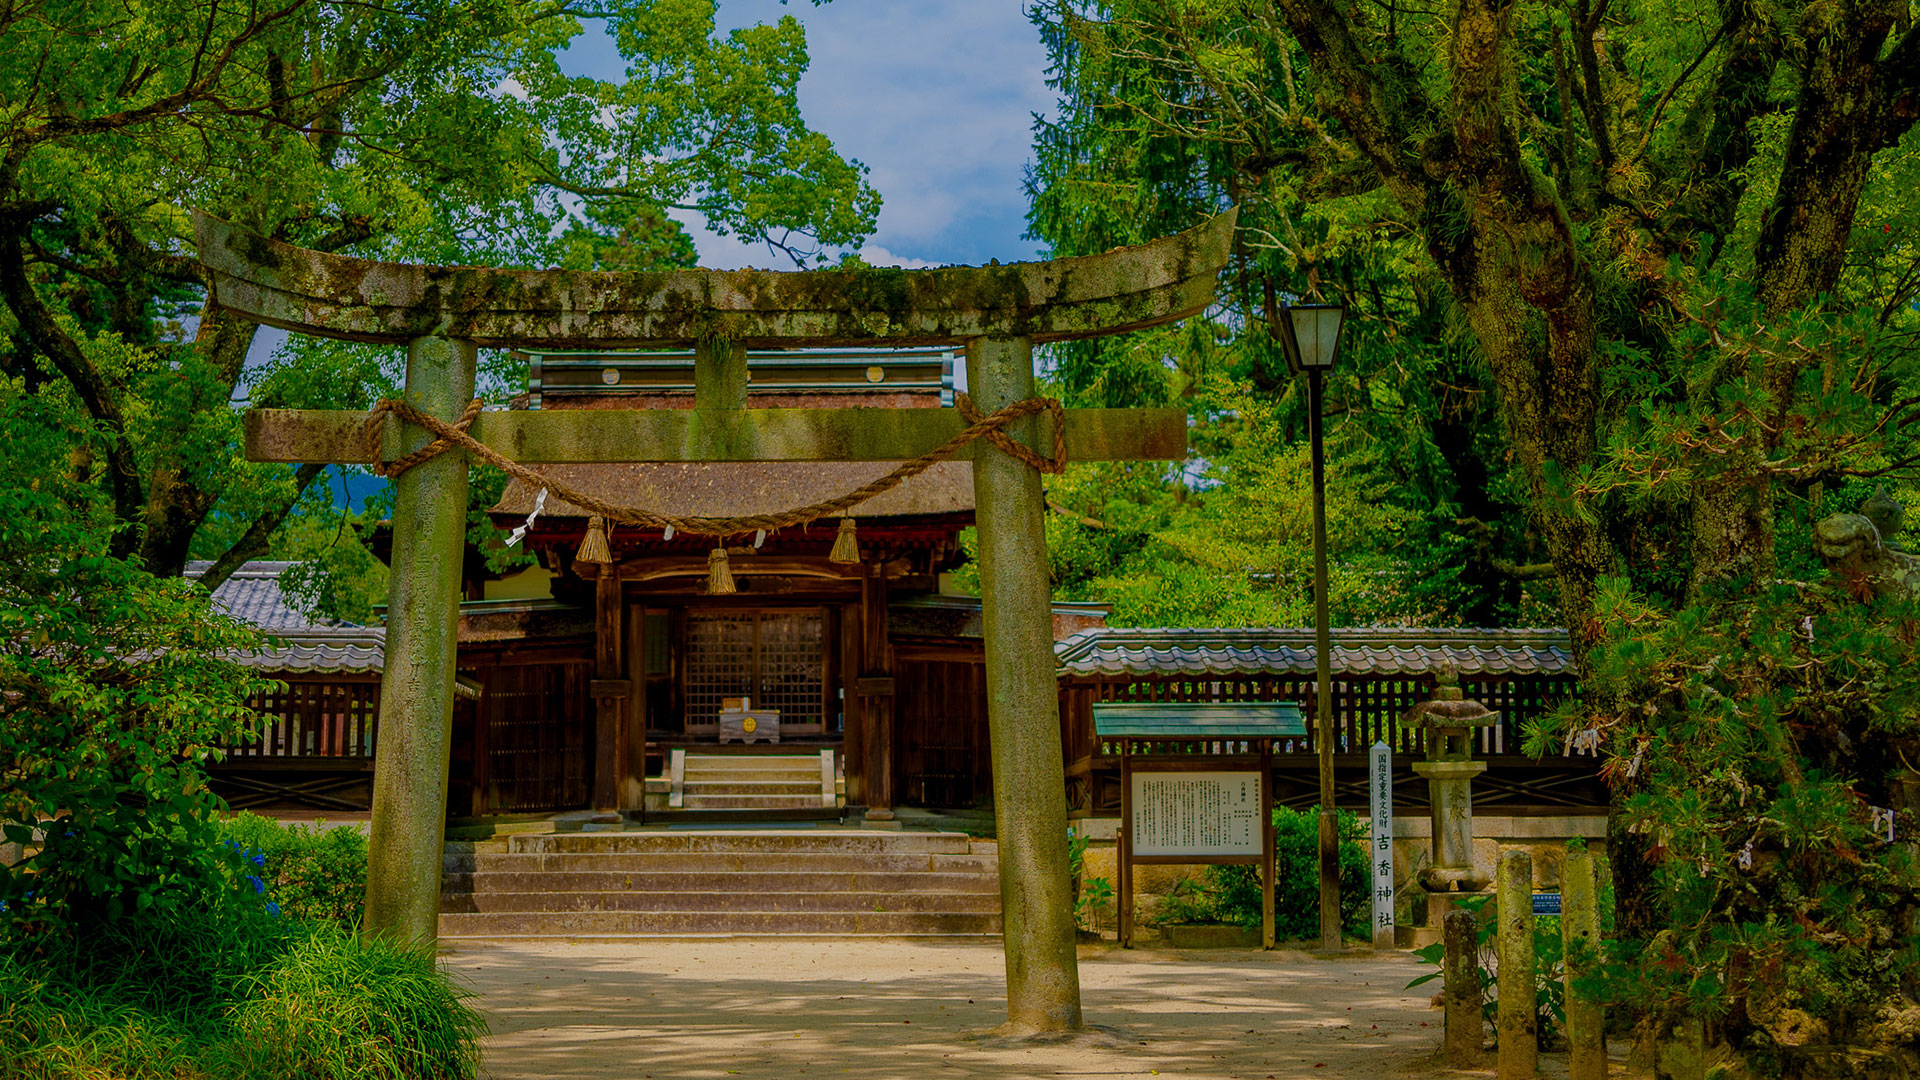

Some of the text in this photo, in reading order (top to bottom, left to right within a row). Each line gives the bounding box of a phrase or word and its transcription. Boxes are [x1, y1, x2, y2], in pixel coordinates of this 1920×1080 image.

[1377, 753, 1393, 928] 国指定重要文化財 吉香神社
